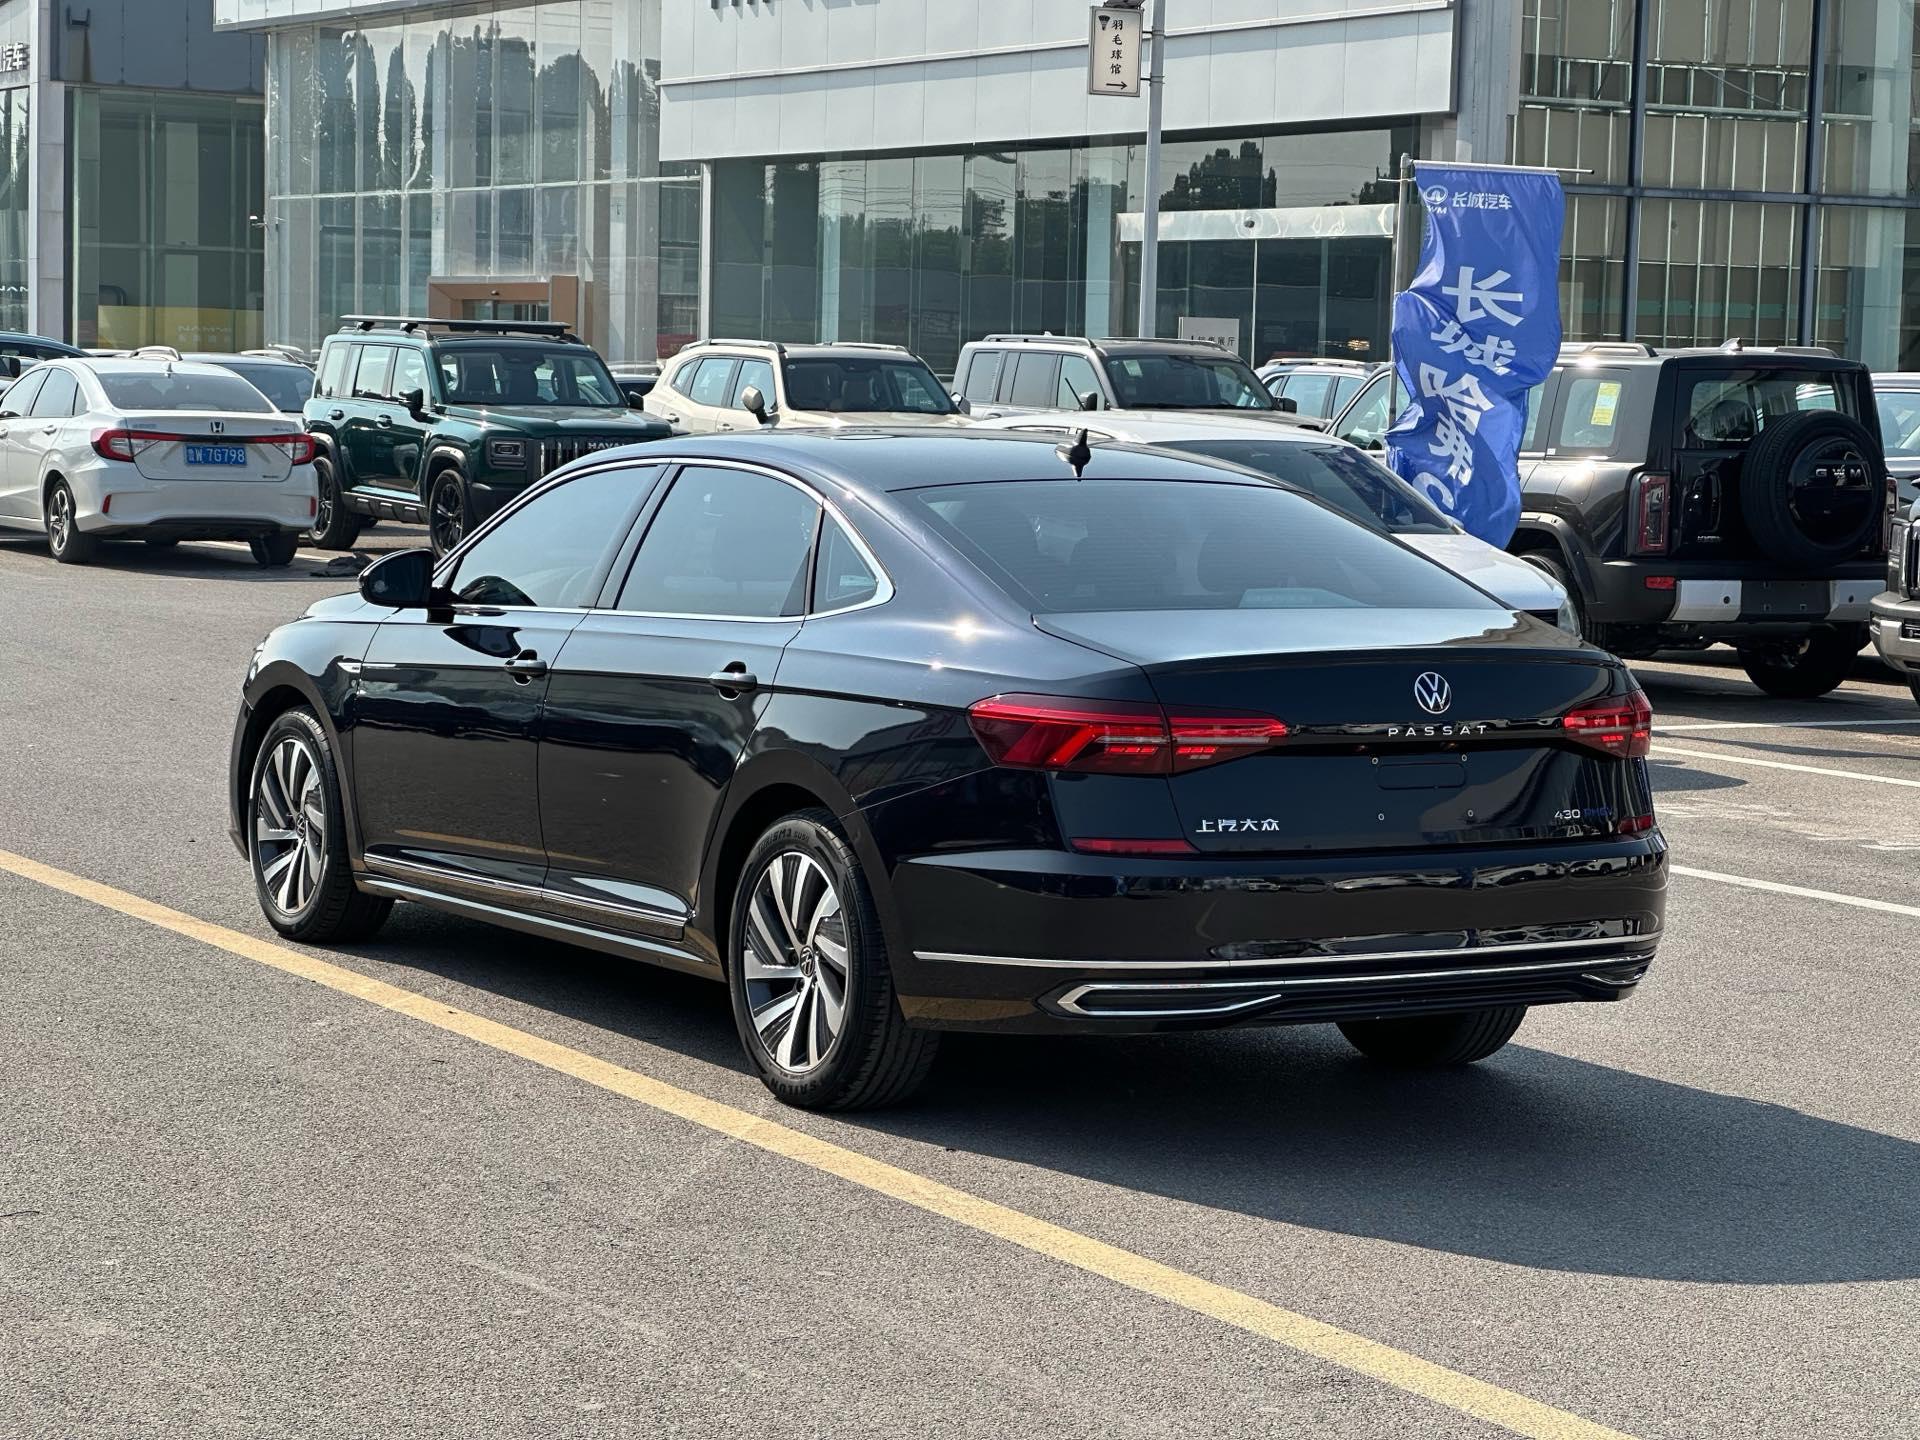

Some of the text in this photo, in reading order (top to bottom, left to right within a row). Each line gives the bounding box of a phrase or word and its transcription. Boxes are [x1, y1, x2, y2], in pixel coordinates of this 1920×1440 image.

[1110, 19, 1124, 75] 羽毛球馆
[0, 42, 24, 72] 汽车
[1452, 191, 1513, 210] 长城汽车
[587, 442, 625, 450] HAVA
[1387, 725, 1487, 737] PASSAT
[1554, 808, 1581, 820] 430
[1195, 818, 1280, 833] 上汽大众
